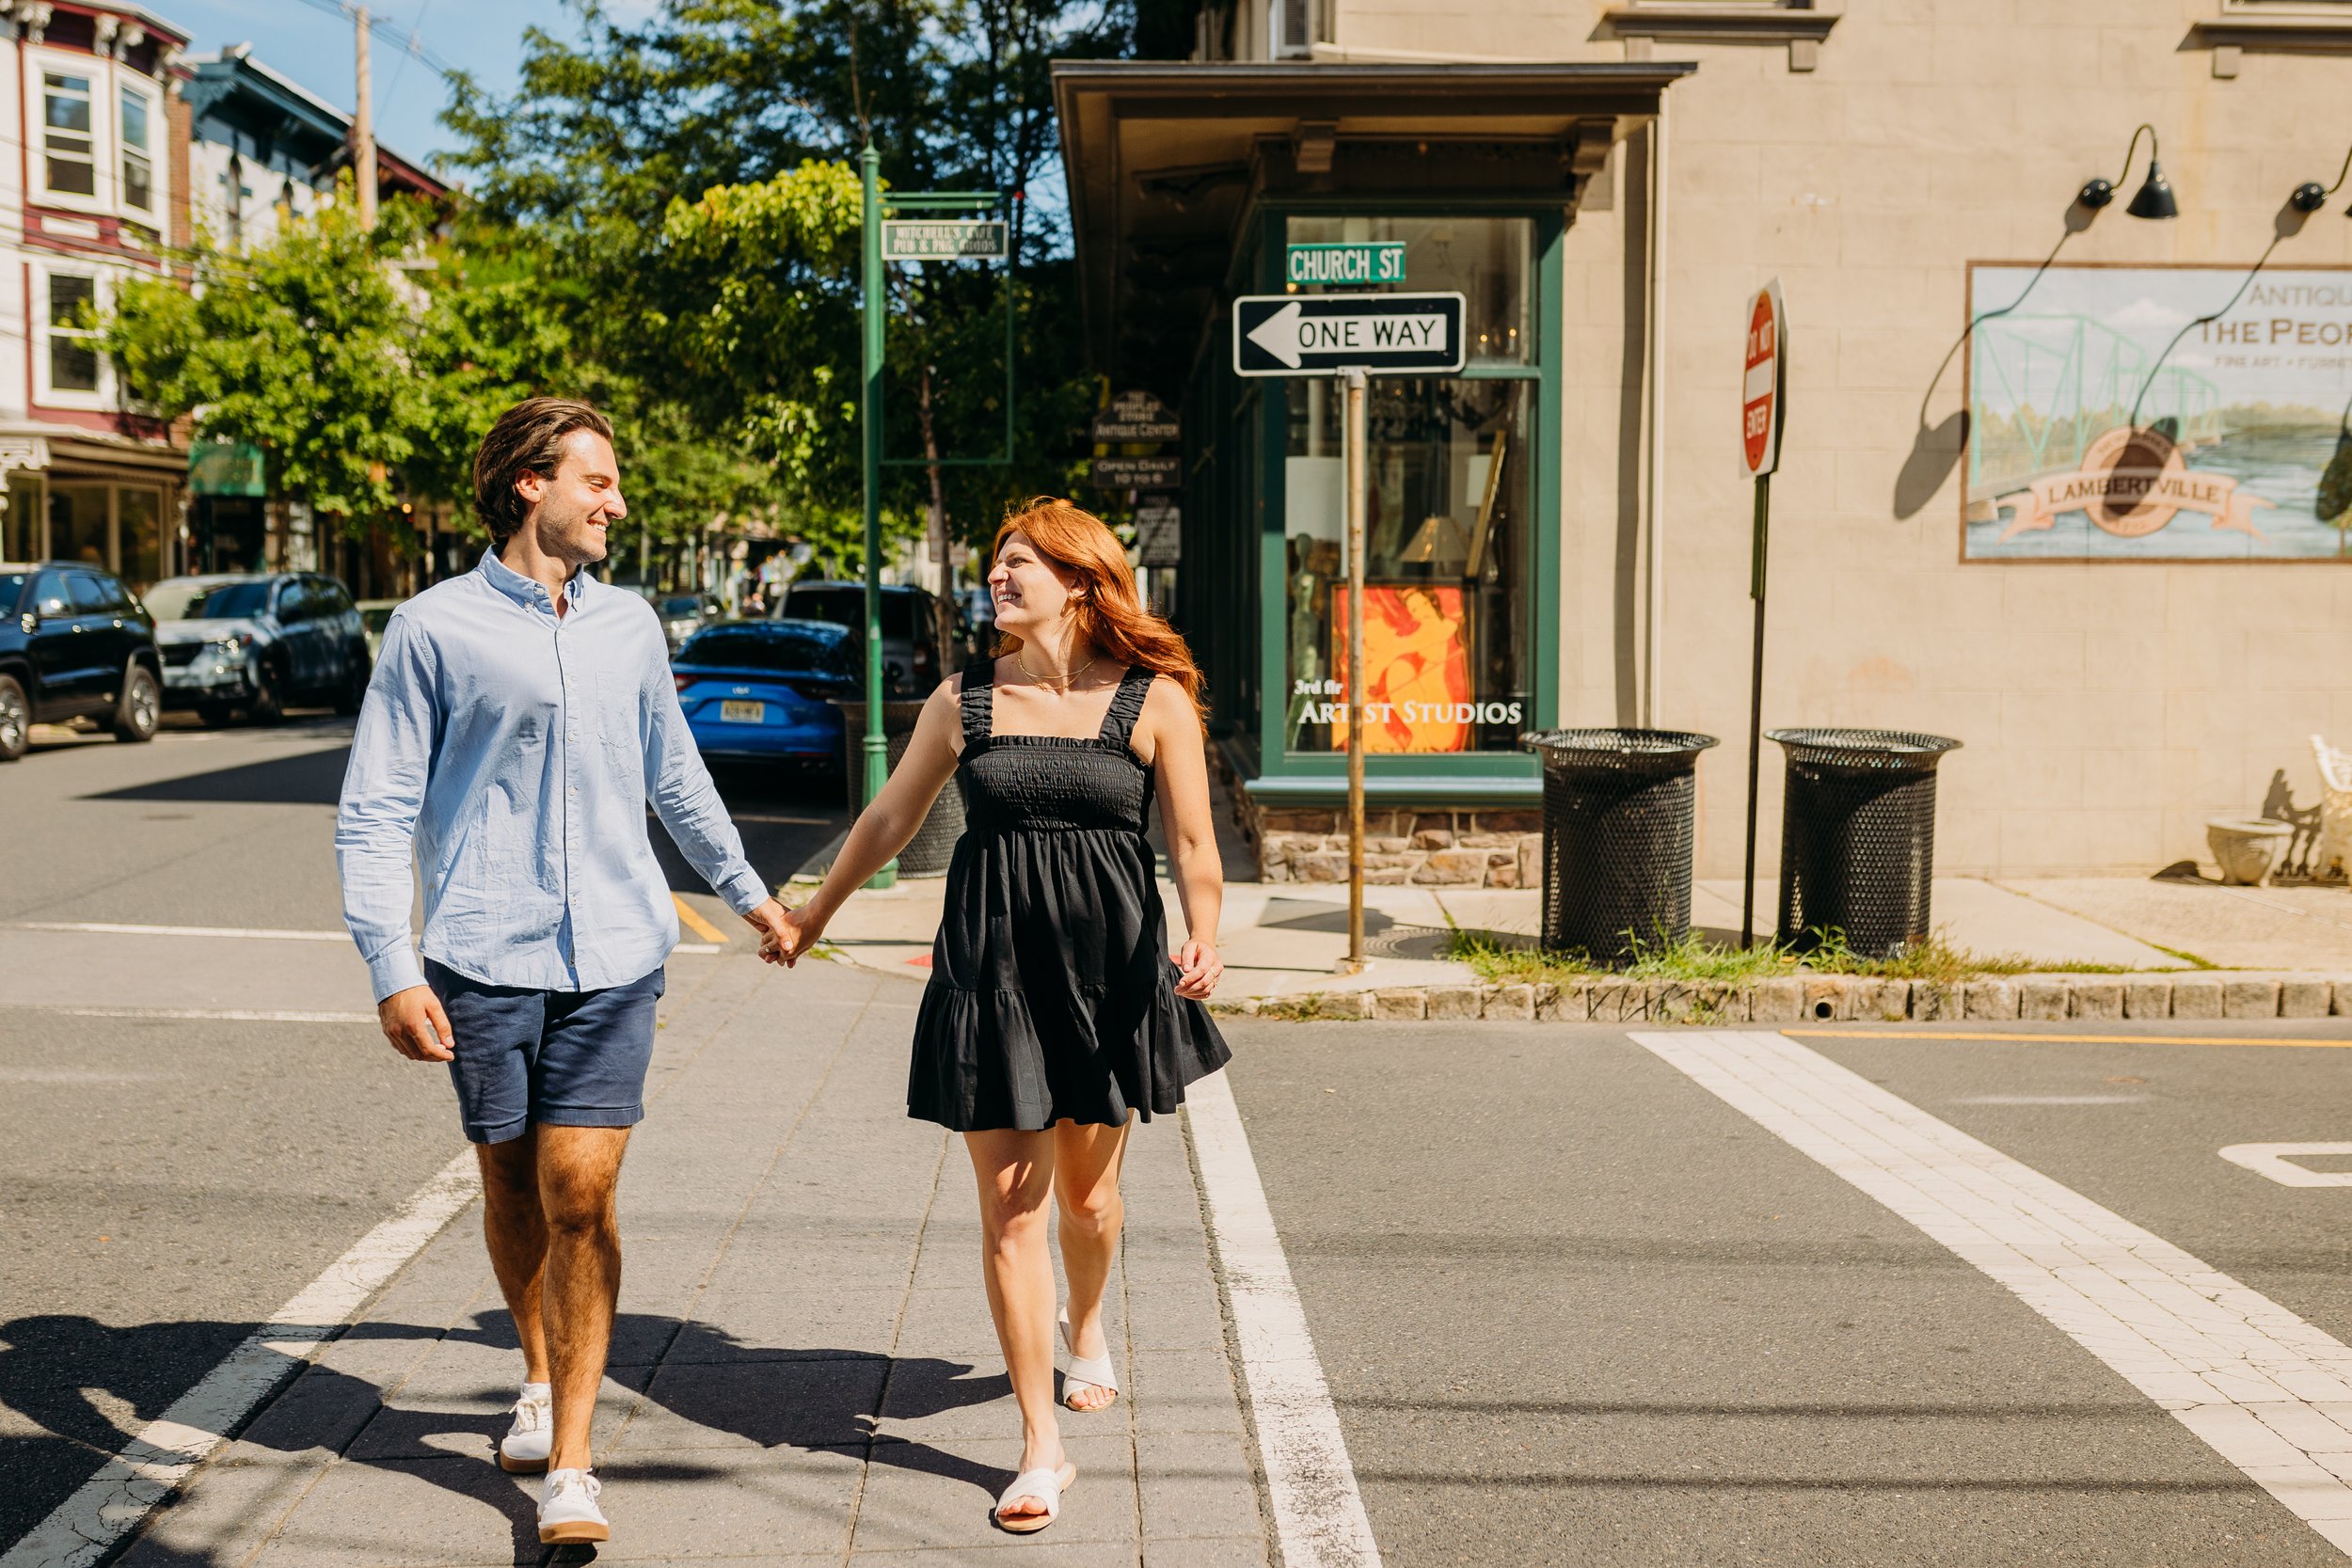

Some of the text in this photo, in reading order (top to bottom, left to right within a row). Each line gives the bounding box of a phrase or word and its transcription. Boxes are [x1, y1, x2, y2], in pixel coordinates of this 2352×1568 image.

[1291, 248, 1404, 280] CHURCH ST
[1299, 320, 1437, 348] ONE WAY
[2199, 318, 2260, 344] THE
[1096, 423, 1179, 437] ANTIQUE CENTER
[1098, 459, 1175, 472] OPEN DAILY
[2048, 475, 2219, 504] LAMBERTVILLE
[1294, 679, 1343, 694] 3rd flr
[1297, 699, 1522, 724] ARTST STUDIOS
